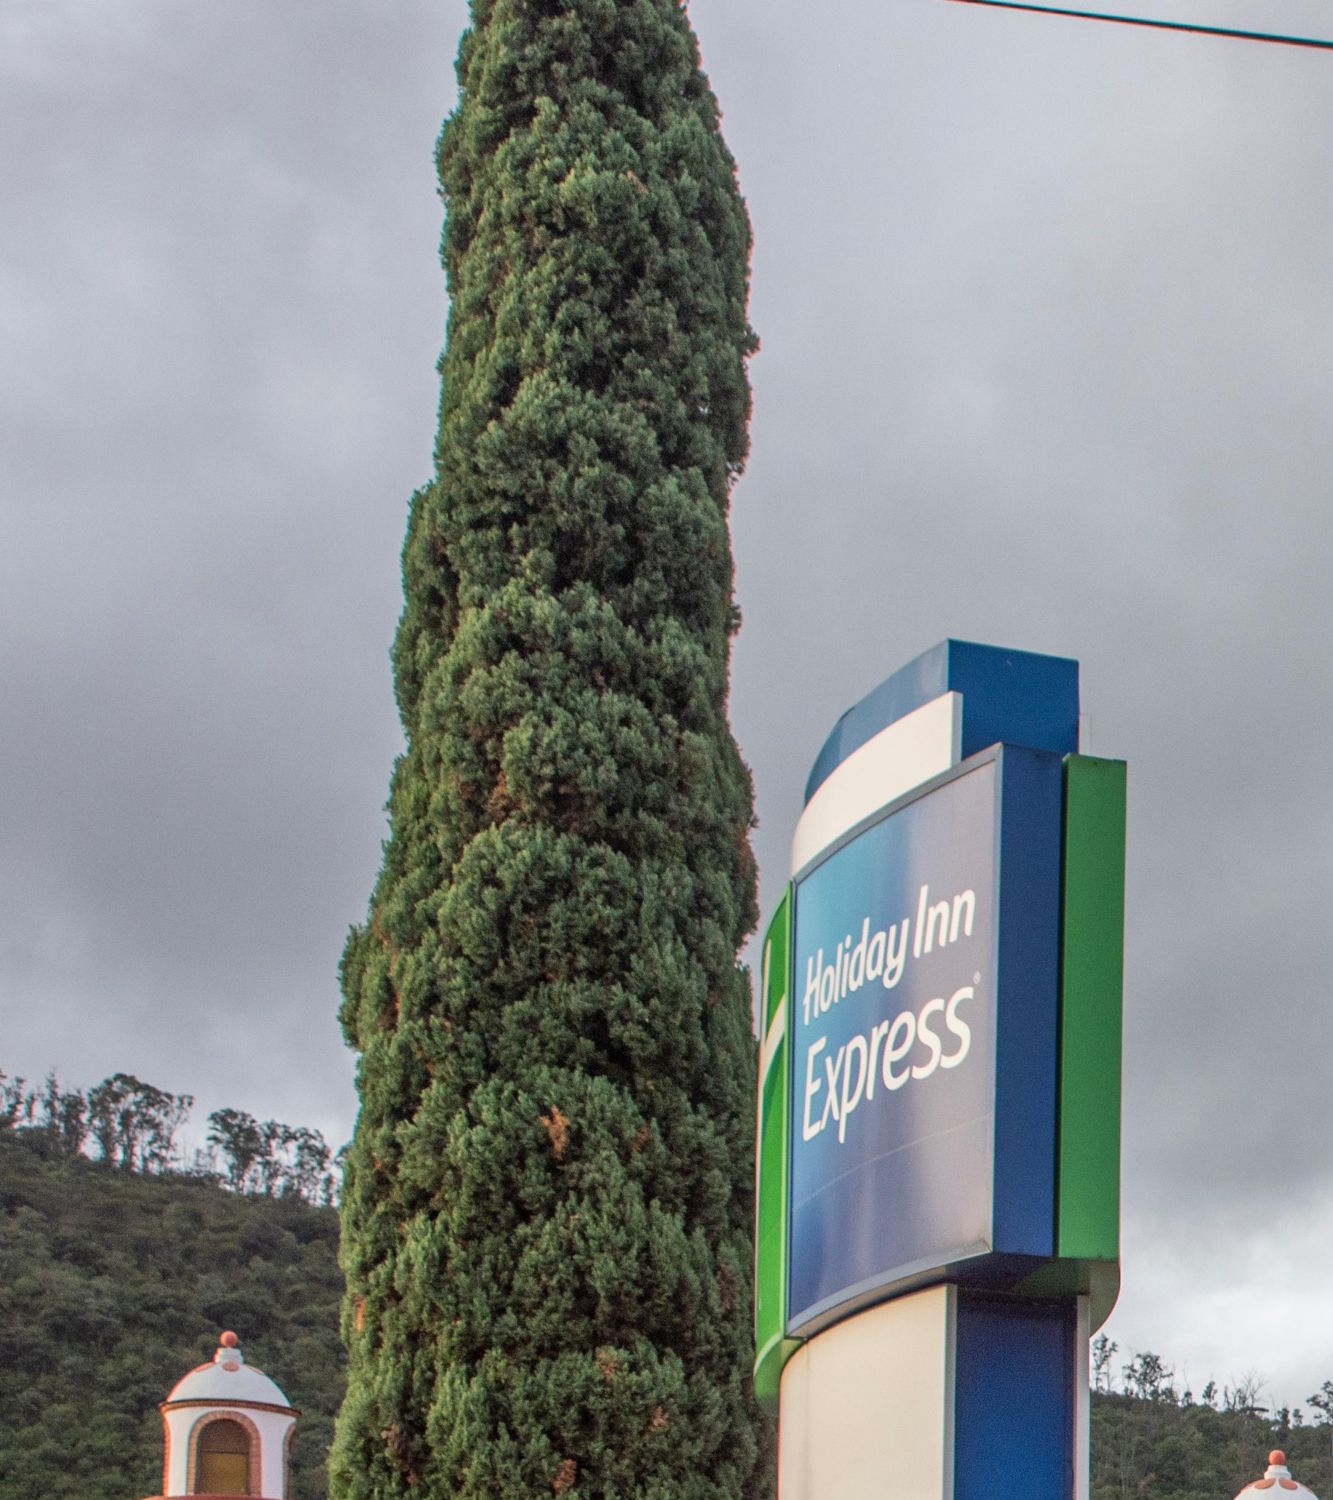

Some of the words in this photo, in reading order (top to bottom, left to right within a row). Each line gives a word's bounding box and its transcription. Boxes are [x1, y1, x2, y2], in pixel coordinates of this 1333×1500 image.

[803, 917, 910, 1025] Holiday
[913, 884, 976, 958] Inn
[803, 986, 974, 1144] Express
